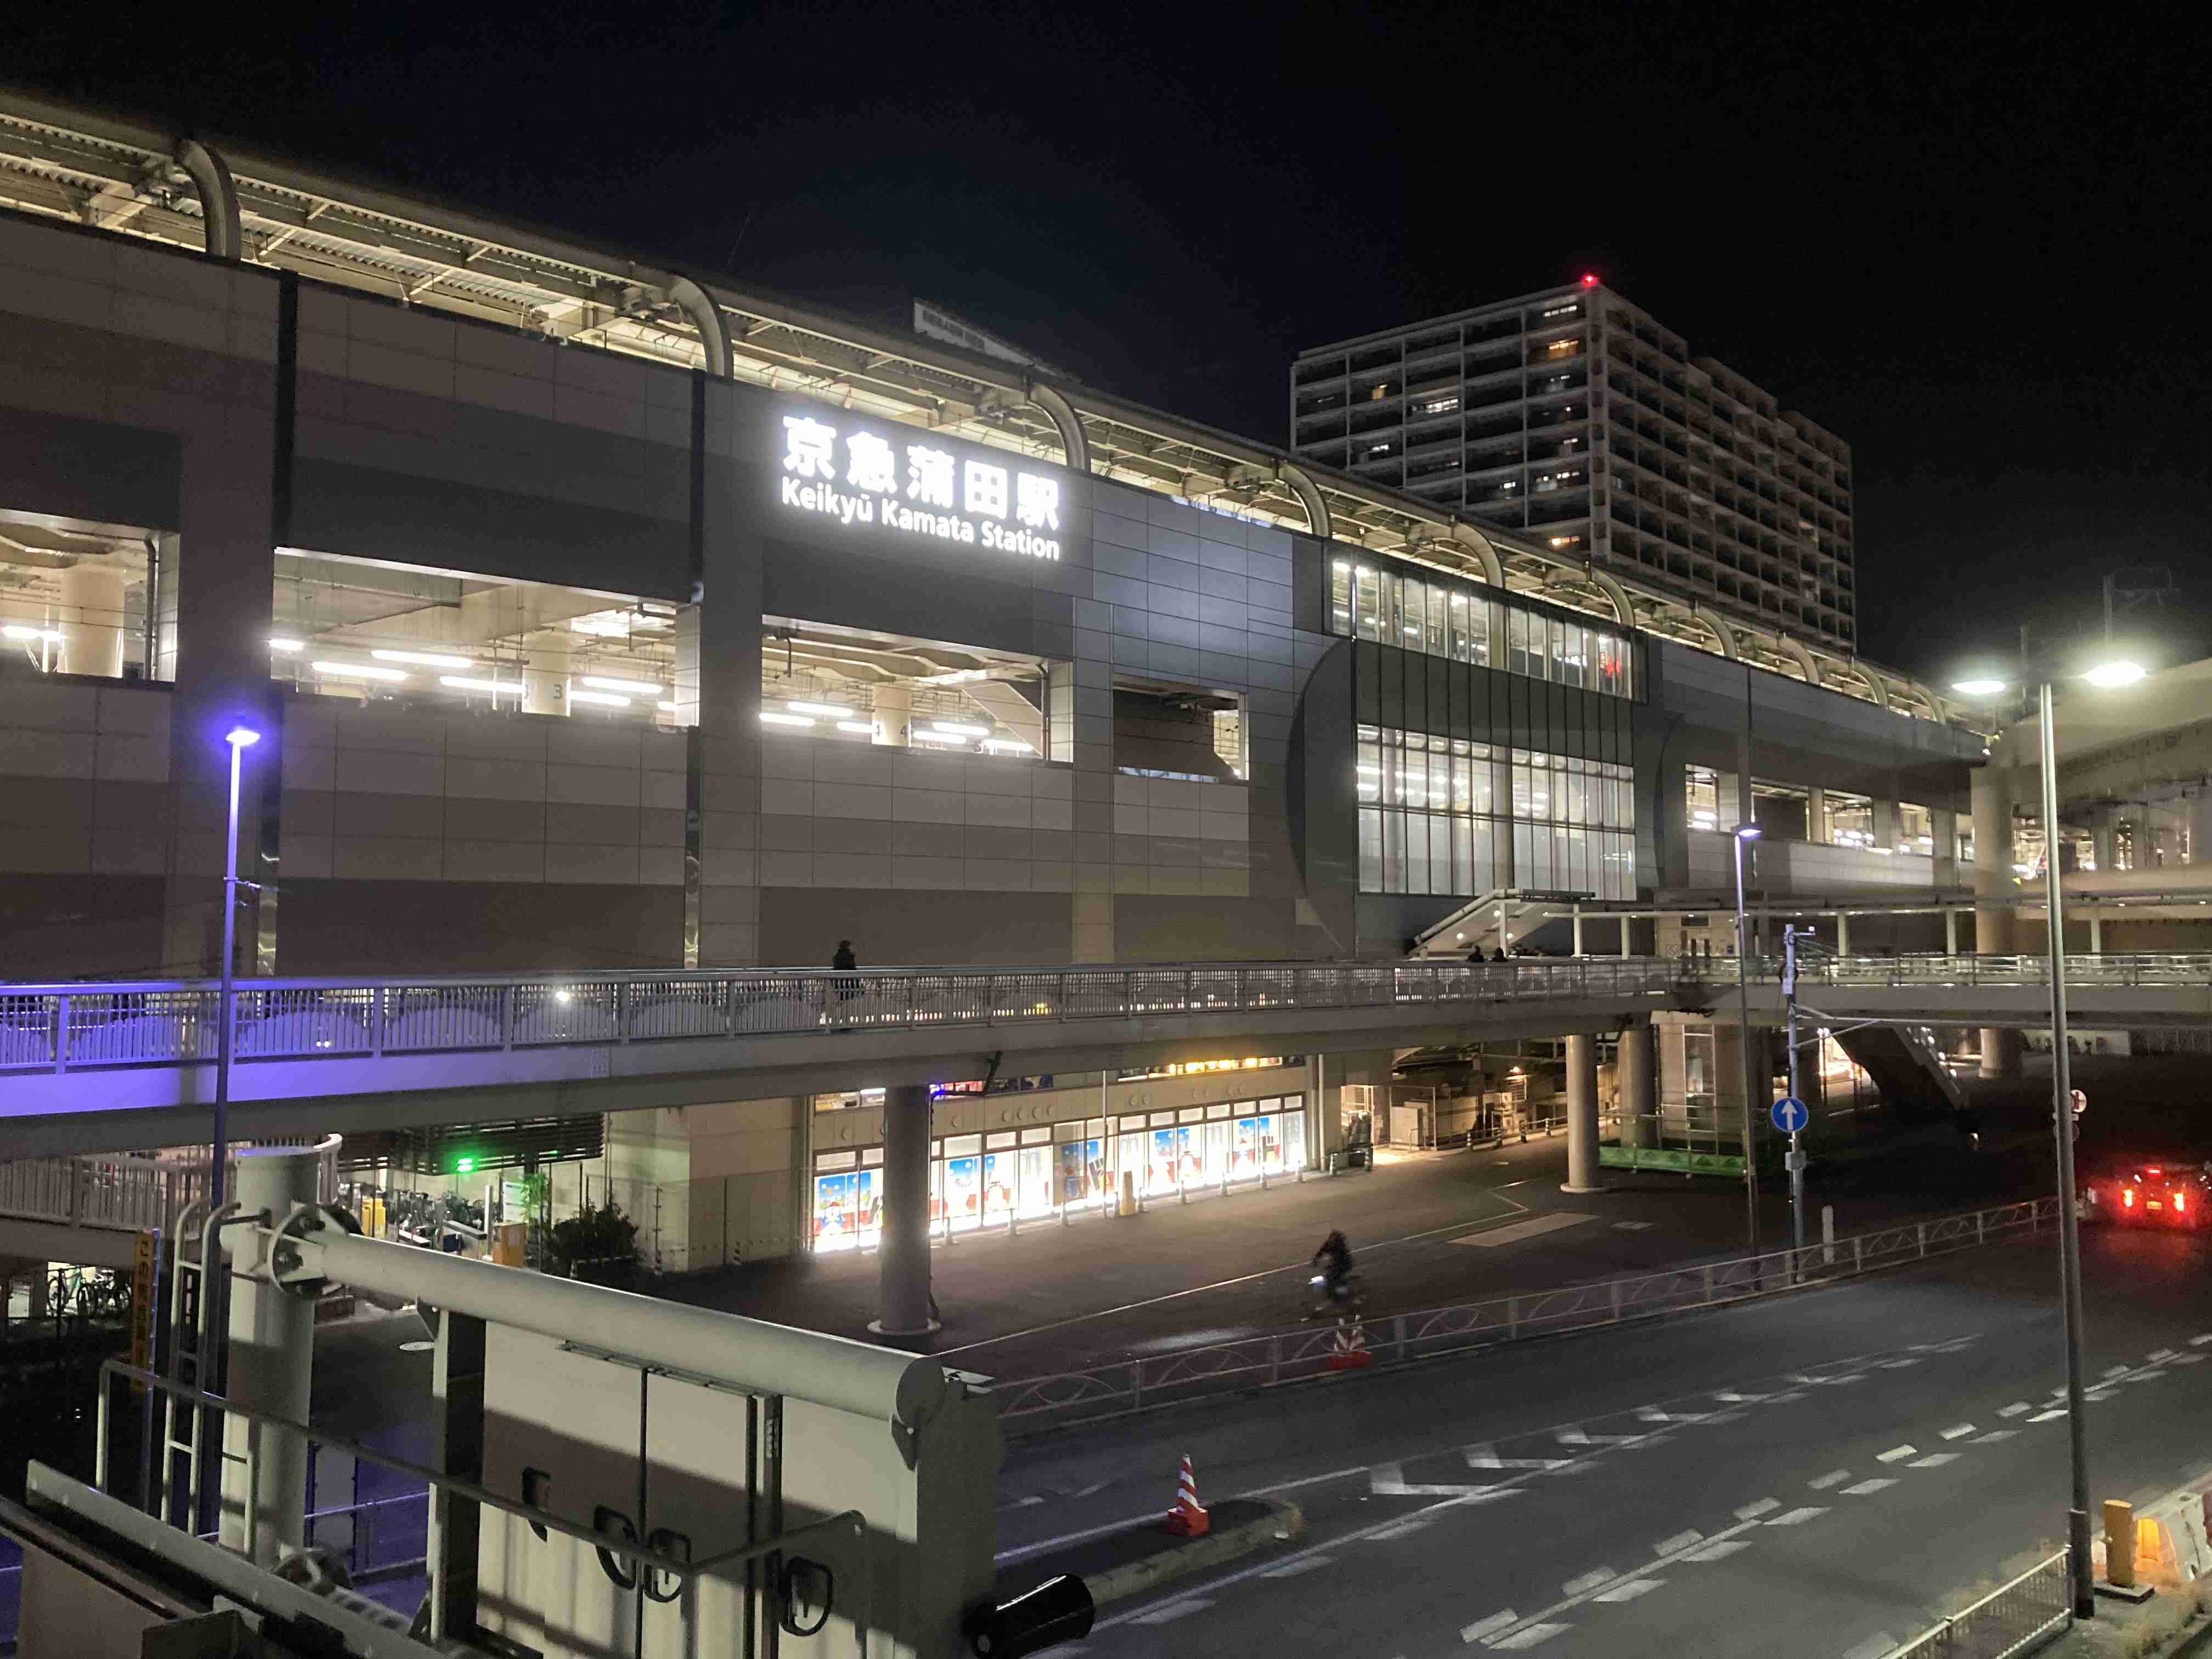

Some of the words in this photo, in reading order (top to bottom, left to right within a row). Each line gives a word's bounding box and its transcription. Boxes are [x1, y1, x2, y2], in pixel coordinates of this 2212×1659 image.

[783, 416, 1059, 531] 京急蒲田駅
[782, 476, 873, 524] Keikyū
[882, 498, 974, 543] Kamata
[981, 521, 1059, 562] Station
[553, 684, 562, 699] 3
[900, 724, 907, 737] 4
